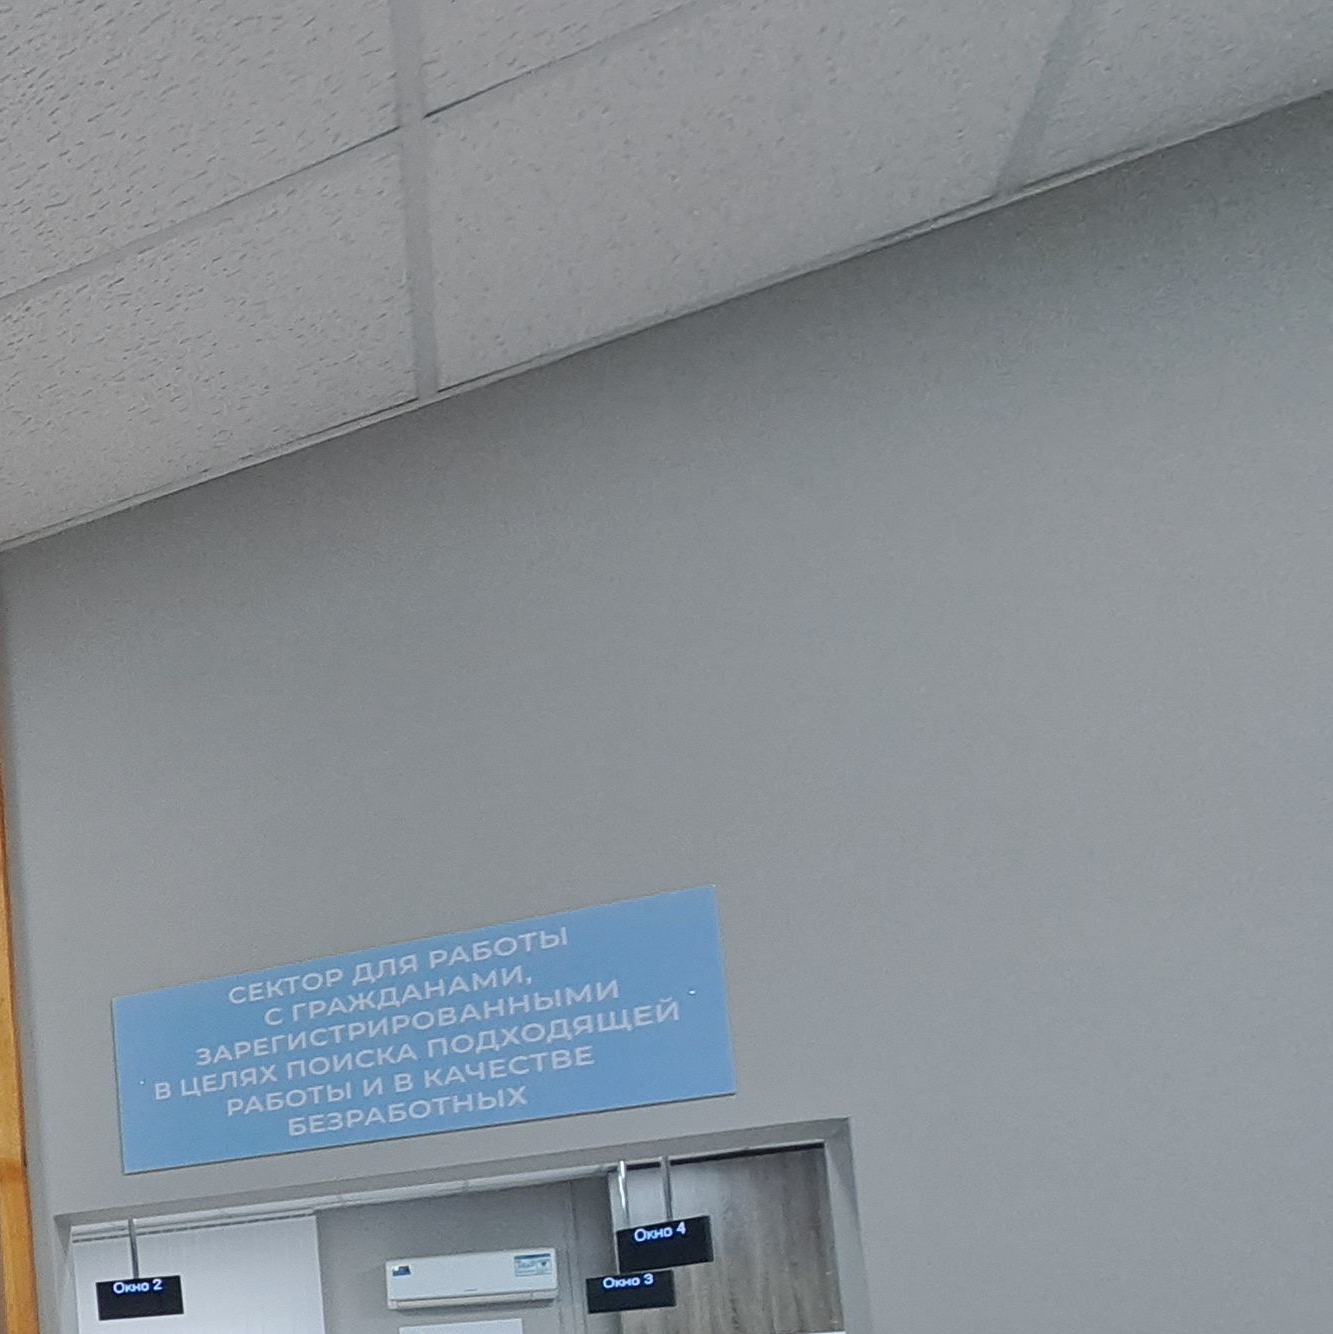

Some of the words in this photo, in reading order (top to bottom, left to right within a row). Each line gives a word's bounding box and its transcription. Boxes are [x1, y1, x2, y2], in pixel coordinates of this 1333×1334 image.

[228, 968, 343, 1005] СЕКТОР
[351, 954, 418, 986] ДЛЯ
[430, 926, 570, 970] РАБОТЫ
[263, 1005, 284, 1027] С
[292, 965, 534, 1024] ГРАЖДАНАМИ,
[154, 1081, 171, 1101] В
[179, 1064, 278, 1100] ЦЕЛЯХ
[286, 1044, 418, 1080] ПОИСКА
[427, 1000, 680, 1059] ПОДХОДЯЩЕЙ
[194, 979, 620, 1067] ЗАРЕГИСТРИРОВАННЫМИ
[226, 1079, 353, 1117] РАБОТЫ
[362, 1077, 384, 1097] И
[394, 1073, 415, 1093] В
[424, 1045, 595, 1089] КАЧЕСТВЕ
[287, 1086, 527, 1137] БЕЗРАБОТНЫХ
[634, 1226, 674, 1242] Окно
[676, 1221, 687, 1235] 4
[113, 1282, 150, 1294] Окно
[152, 1278, 163, 1291] 2
[602, 1276, 641, 1289] Окно
[643, 1273, 654, 1285] 3
